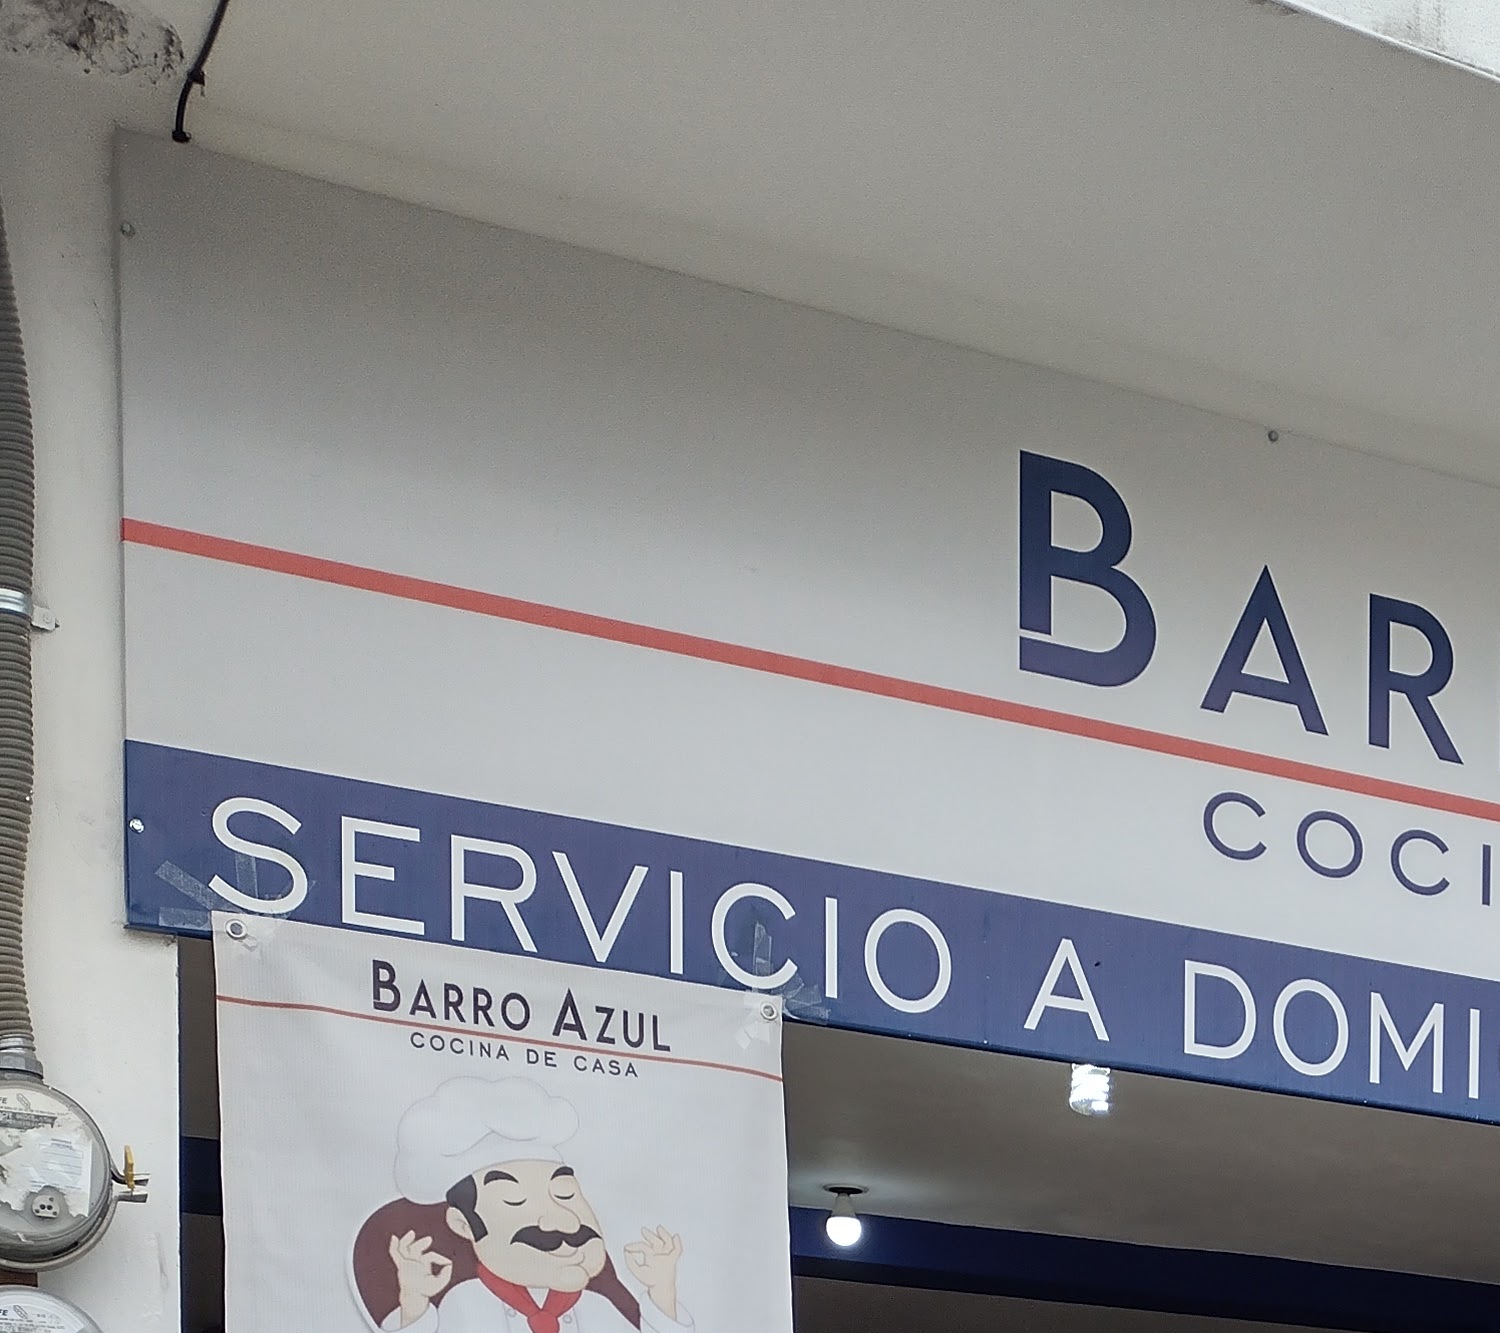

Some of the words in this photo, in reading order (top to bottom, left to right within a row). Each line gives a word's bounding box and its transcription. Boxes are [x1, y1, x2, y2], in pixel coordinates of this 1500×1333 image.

[209, 797, 952, 1013] SERVICIO
[1023, 939, 1110, 1042] A
[372, 959, 531, 1031] BARRO
[552, 988, 671, 1052] AZUL
[410, 1031, 509, 1061] COCINA
[526, 1048, 557, 1068] DE
[574, 1055, 638, 1078] CASA
